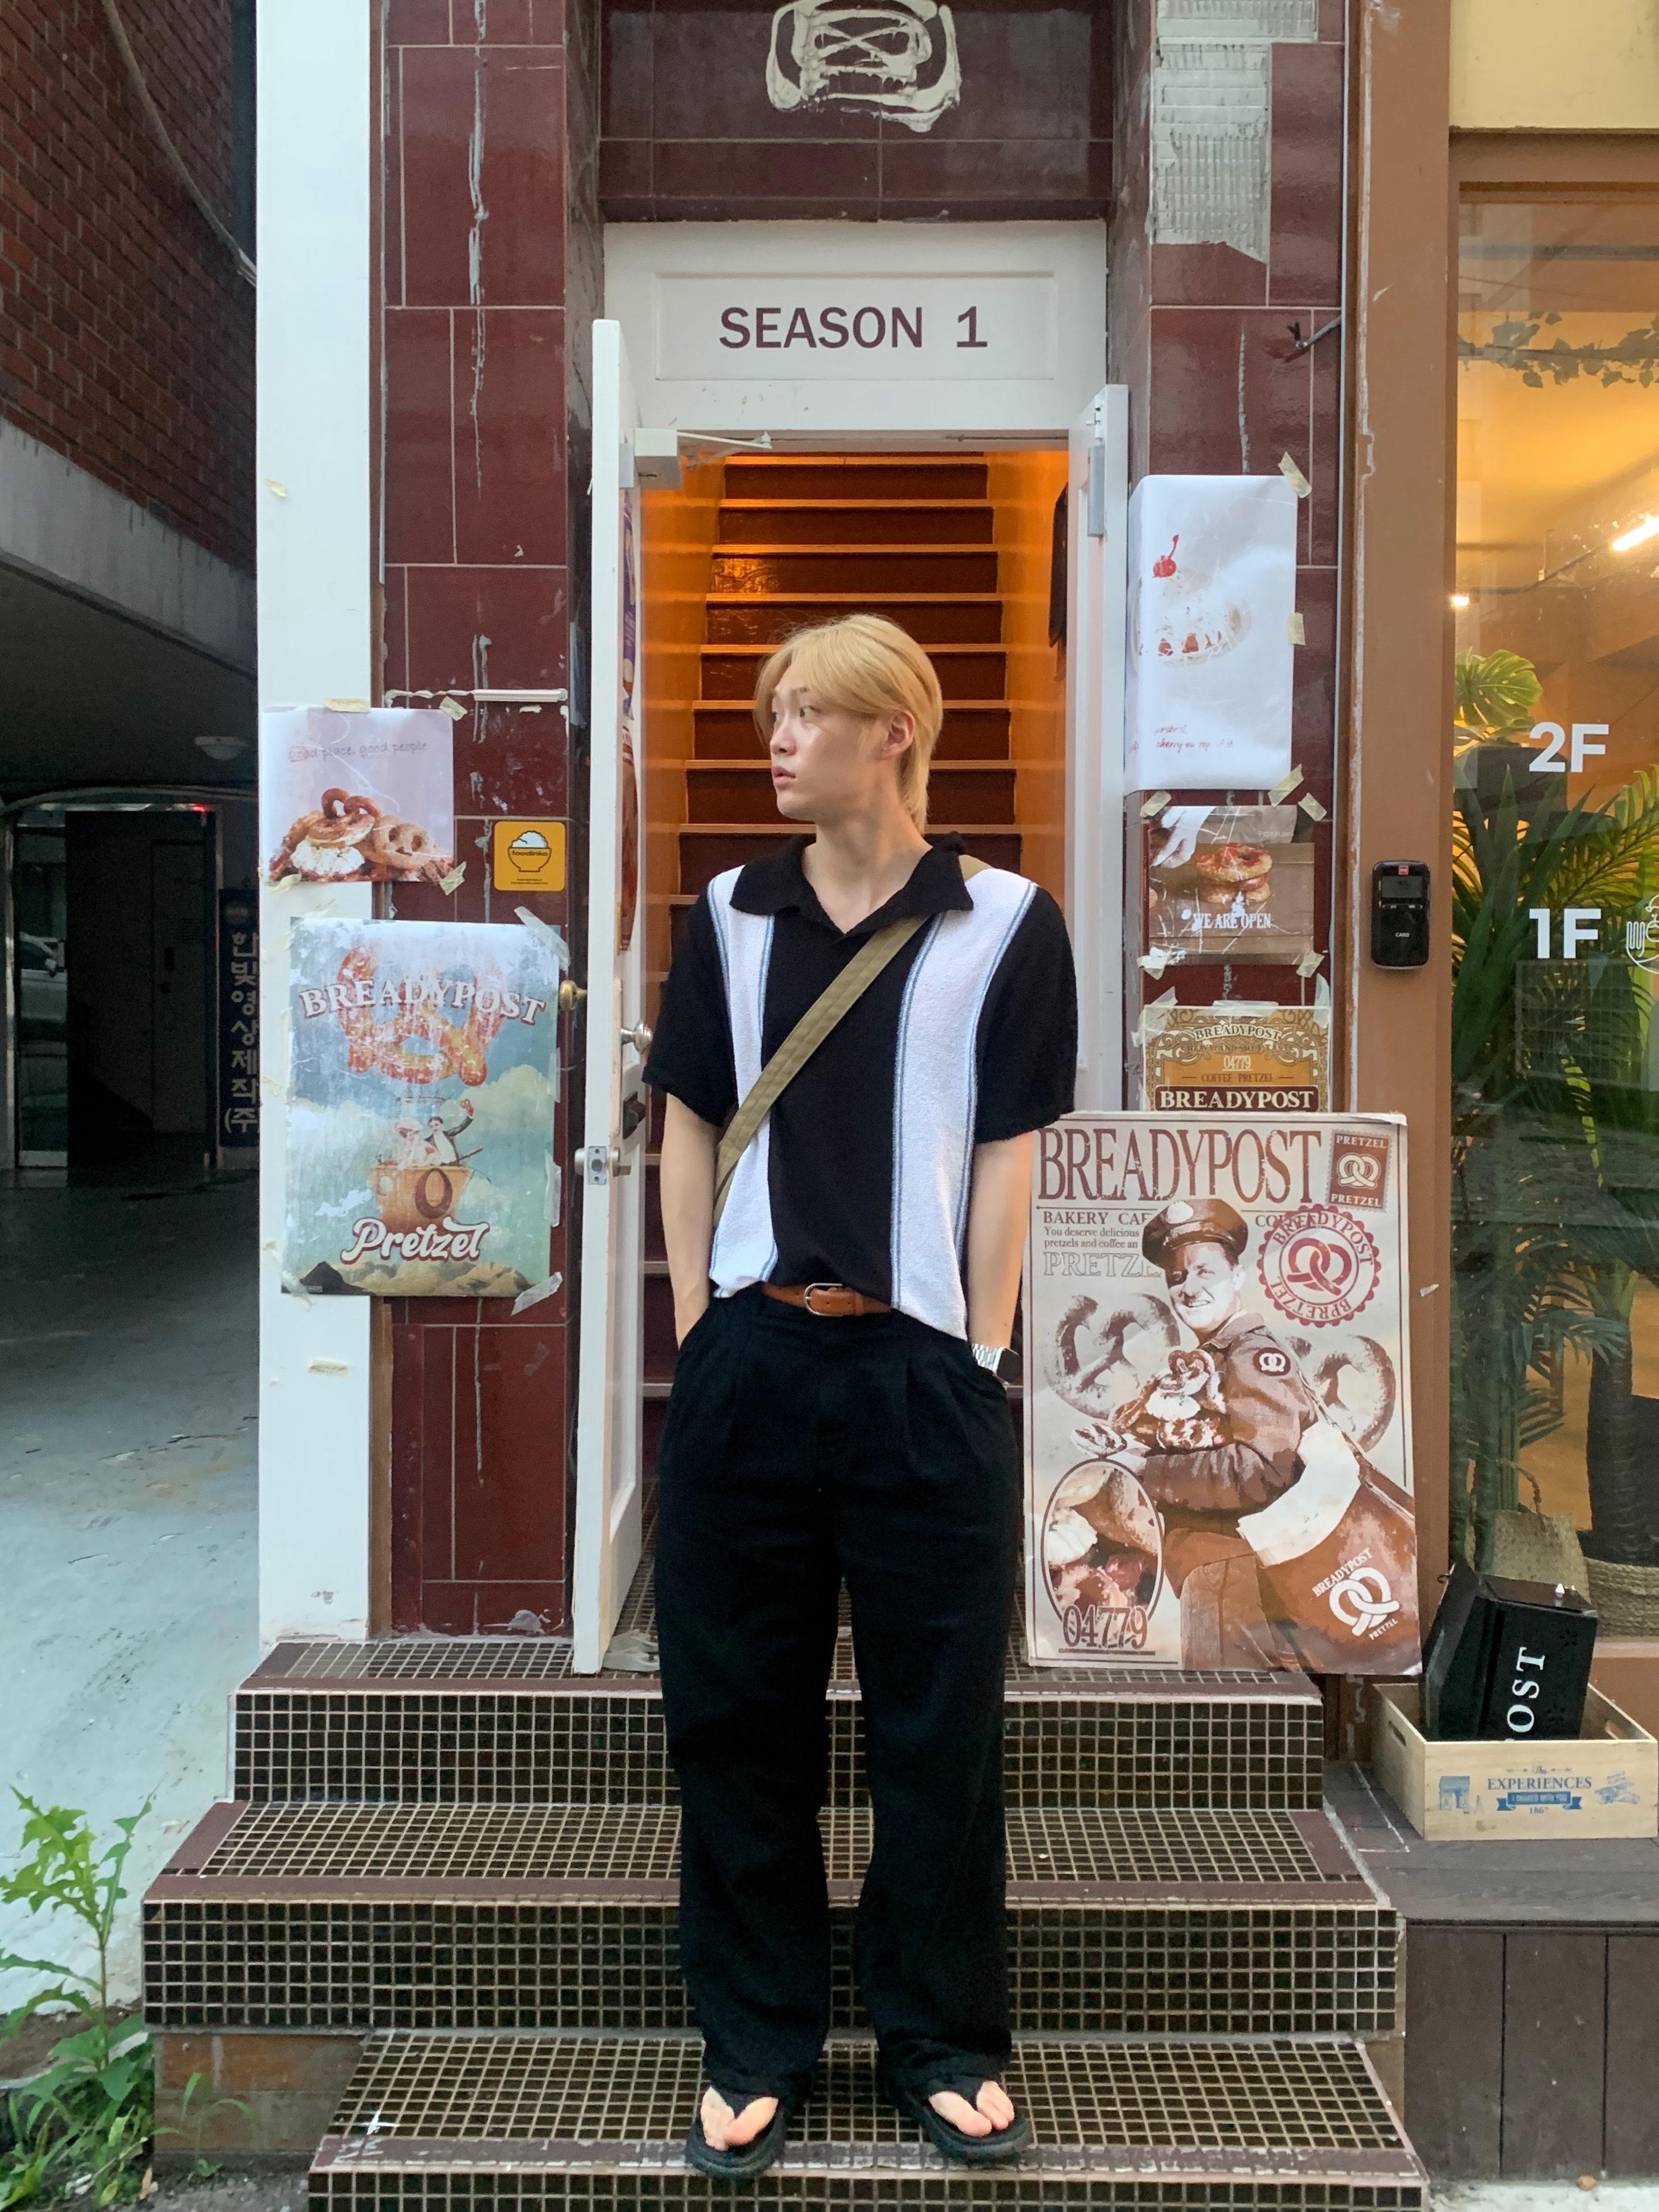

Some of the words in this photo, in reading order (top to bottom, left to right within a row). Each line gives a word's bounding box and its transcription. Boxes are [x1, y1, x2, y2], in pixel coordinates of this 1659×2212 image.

[719, 306, 922, 349] SEASON
[956, 306, 988, 349] 1
[288, 748, 317, 763] good
[359, 742, 388, 757] good
[391, 740, 428, 756] people
[1529, 721, 1609, 773] 2F
[1192, 913, 1212, 929] WE
[1214, 913, 1238, 929] ARE
[1240, 913, 1272, 929] OPEN
[1529, 907, 1602, 959] 1F
[298, 978, 546, 1025] BREADYPOST
[224, 932, 262, 1134] 한빛영상제작(주
[1193, 1025, 1282, 1041] BREADYPOST
[1223, 1055, 1252, 1069] 04779
[1201, 1073, 1232, 1082] COFFEE
[1160, 1091, 1314, 1108] BREADYPOST
[1335, 1134, 1387, 1149] PRETZEL
[1037, 1127, 1322, 1204] BREADYPOST
[1330, 1193, 1382, 1207] PRETZEL
[1043, 1211, 1109, 1225] BAKERY
[1118, 1212, 1154, 1225] CAF
[340, 1216, 491, 1266] Pretzel
[1044, 1226, 1063, 1236] You
[1064, 1226, 1097, 1236] deserve
[1099, 1227, 1139, 1237] delicious
[1272, 1212, 1374, 1266] BREADYPOST
[1044, 1238, 1079, 1249] pretzels
[1080, 1238, 1097, 1248] and
[1098, 1239, 1126, 1248] coffee
[1043, 1251, 1163, 1278] PRETZE
[1311, 1547, 1373, 1598] BREADYPOST
[1062, 1604, 1149, 1649] 04779
[1368, 1618, 1399, 1640] PRETZEL
[1505, 1646, 1546, 1742] OST
[1487, 1776, 1593, 1790] EXPERIENCES
